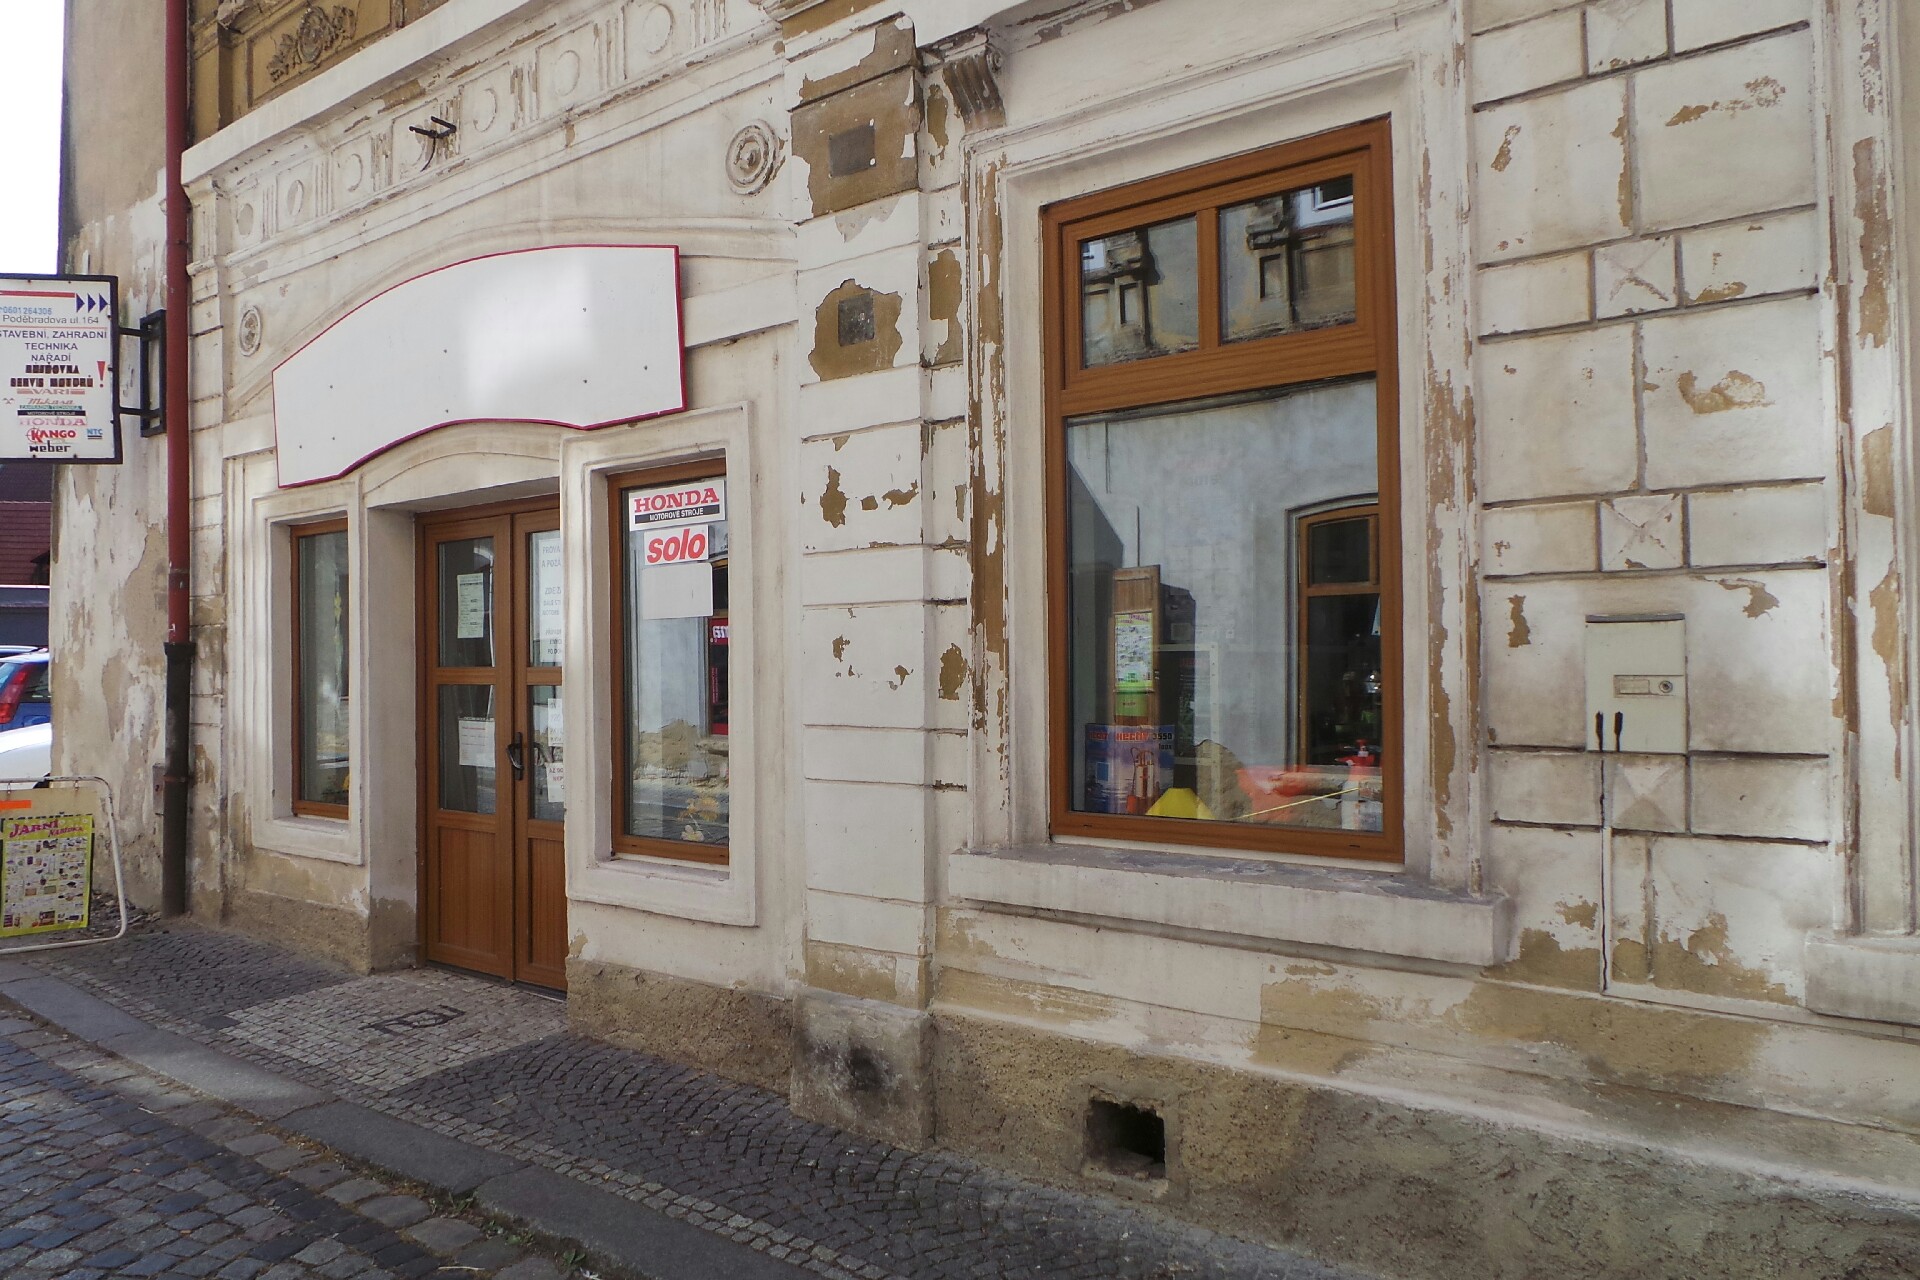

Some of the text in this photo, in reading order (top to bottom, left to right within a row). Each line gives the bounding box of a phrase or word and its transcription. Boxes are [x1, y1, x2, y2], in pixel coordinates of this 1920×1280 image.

[25, 342, 78, 351] TECHNIKA
[10, 377, 44, 388] SERVIS
[20, 418, 87, 426] HONDA
[30, 429, 77, 443] KANGO
[29, 440, 71, 453] weber
[634, 487, 720, 513] HONDA
[680, 507, 704, 518] STROJE
